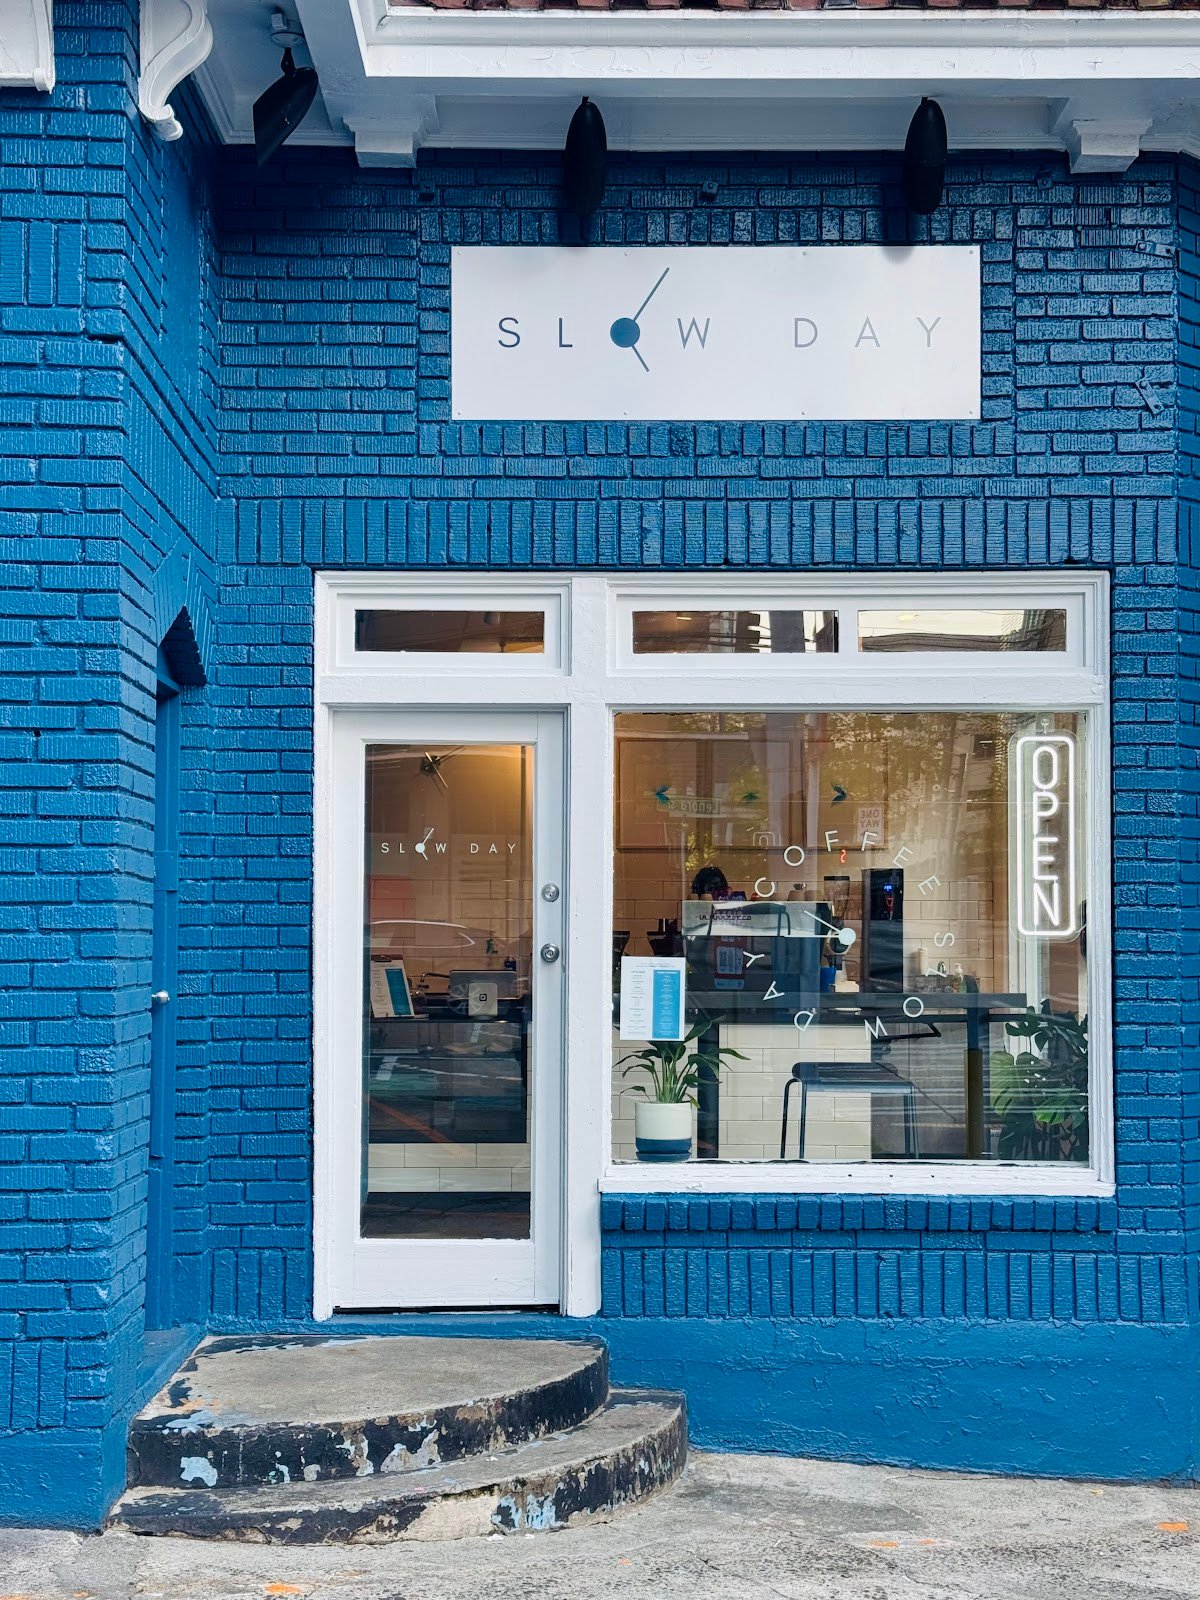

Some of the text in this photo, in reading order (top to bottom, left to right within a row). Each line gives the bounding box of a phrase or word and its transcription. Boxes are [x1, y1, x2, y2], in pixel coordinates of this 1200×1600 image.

[794, 315, 942, 349] DAY
[470, 843, 516, 854] DAY
[754, 829, 940, 897] COFFEE
[1031, 745, 1061, 928] OPEN
[742, 951, 816, 1032] DAY
